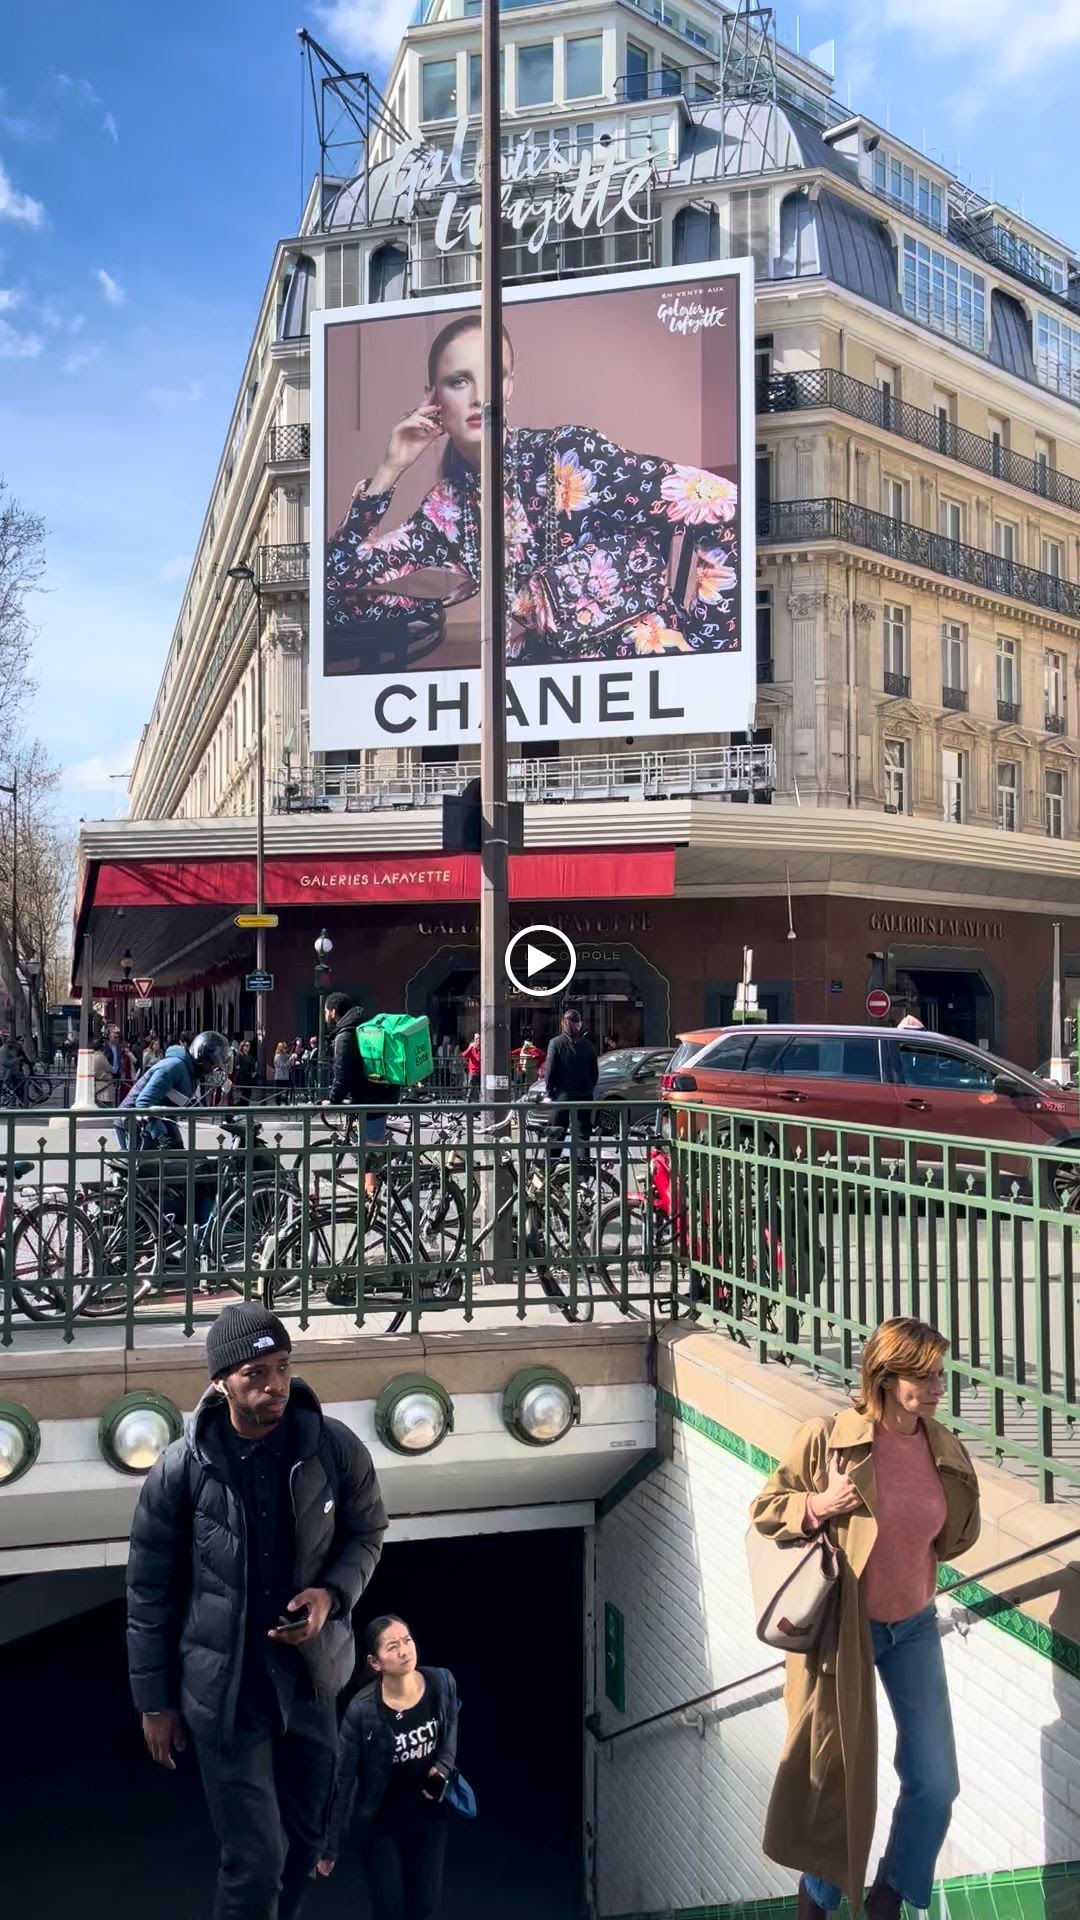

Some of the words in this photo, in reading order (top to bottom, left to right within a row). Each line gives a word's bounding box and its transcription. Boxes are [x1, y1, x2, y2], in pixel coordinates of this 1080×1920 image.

[657, 298, 704, 323] Galeries
[669, 306, 728, 335] Lafayette
[300, 874, 369, 887] GALERIES
[373, 870, 451, 885] LAFAYETTE
